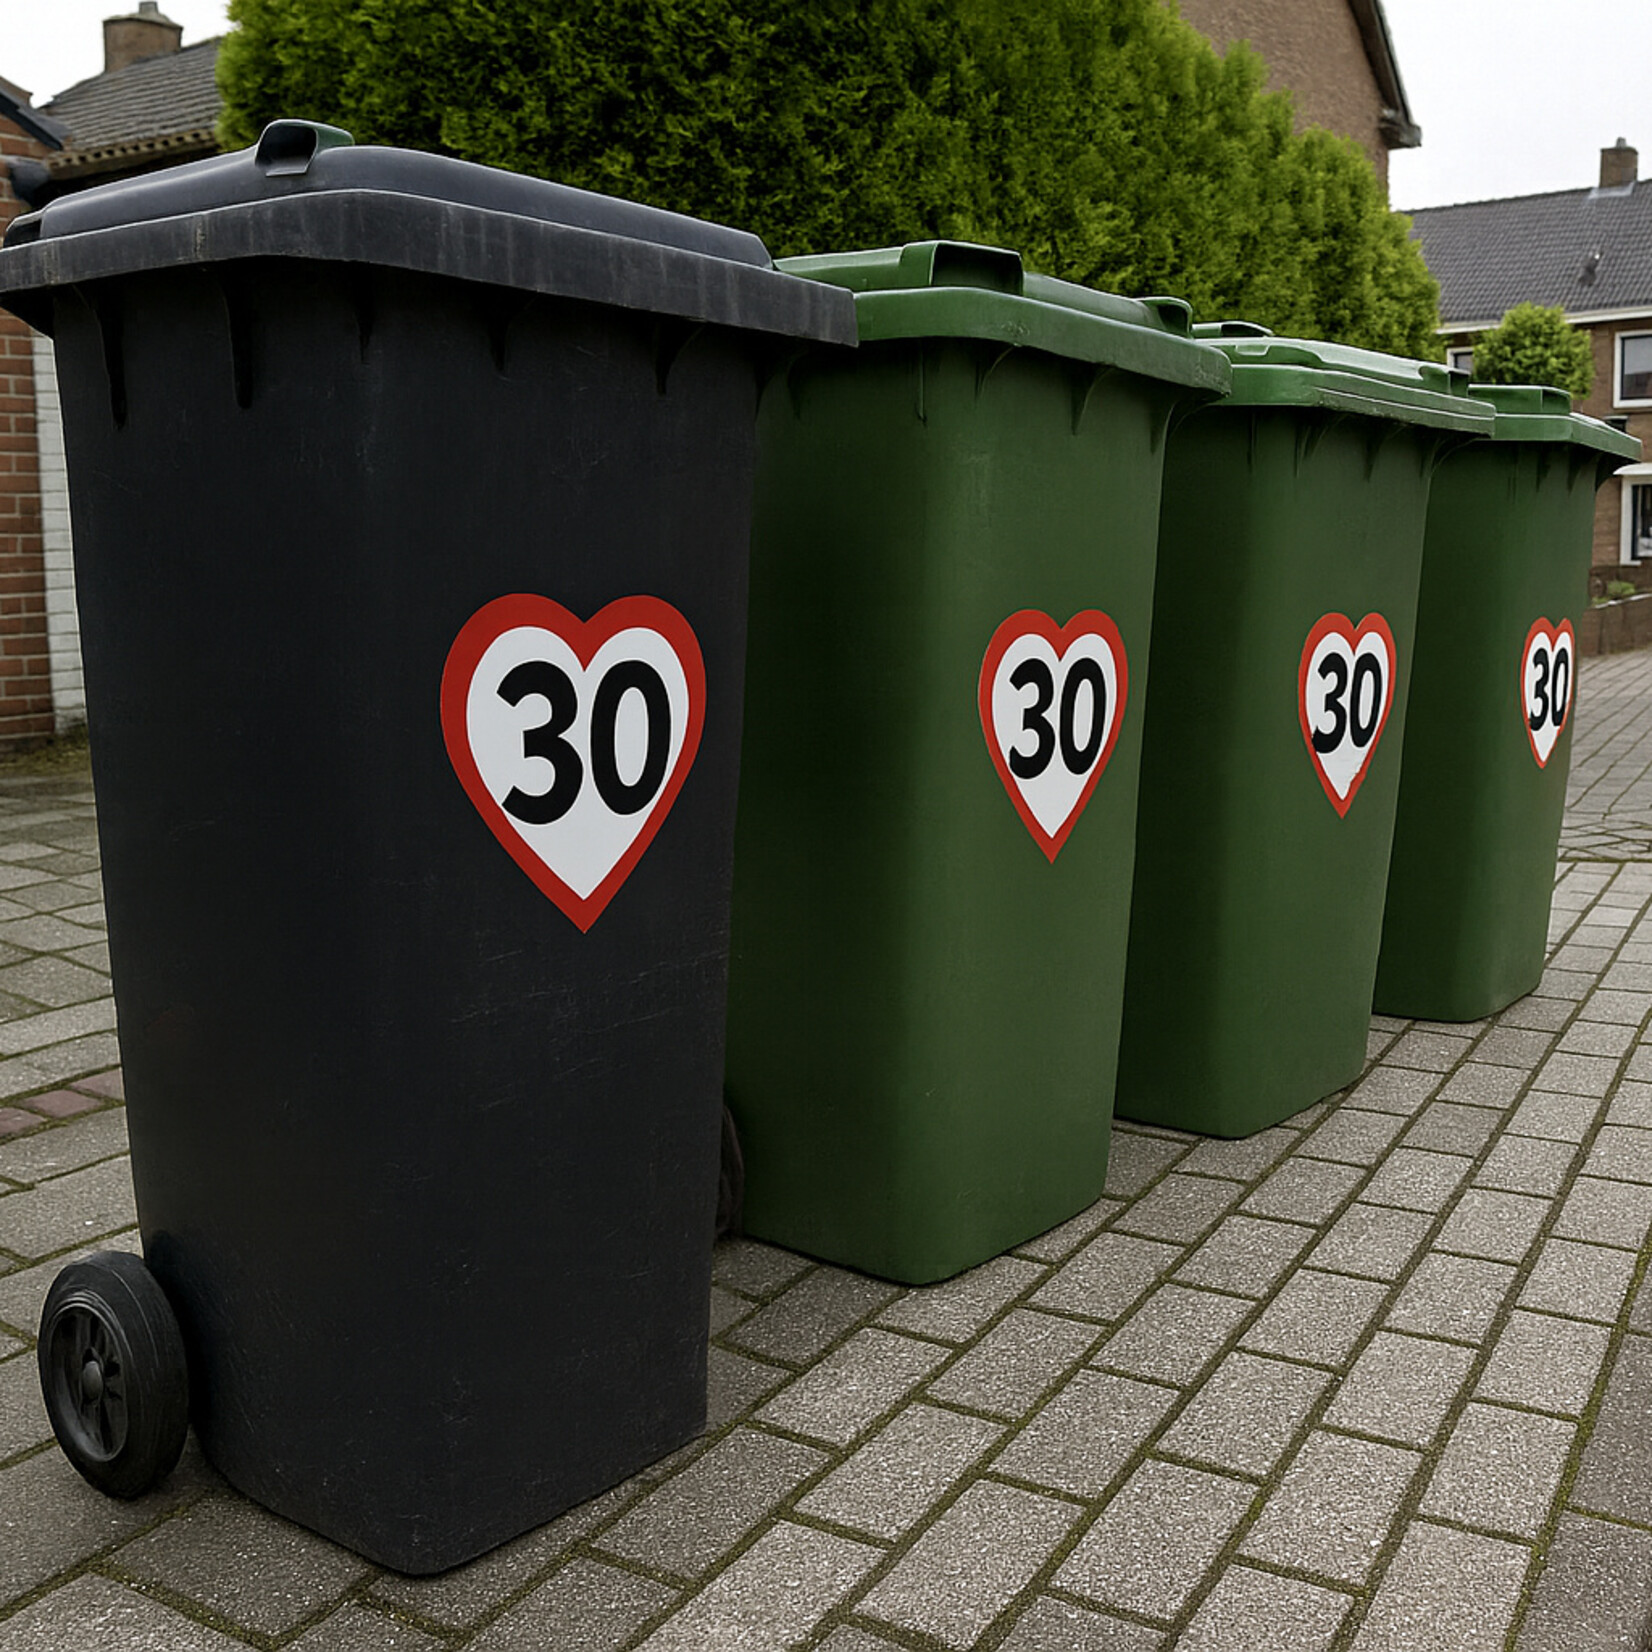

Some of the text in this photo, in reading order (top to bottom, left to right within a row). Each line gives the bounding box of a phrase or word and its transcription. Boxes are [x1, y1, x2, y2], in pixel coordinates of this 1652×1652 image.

[497, 660, 671, 825] 30
[1009, 658, 1107, 780] 30
[1311, 652, 1383, 754] 30
[1529, 647, 1569, 732] 30
